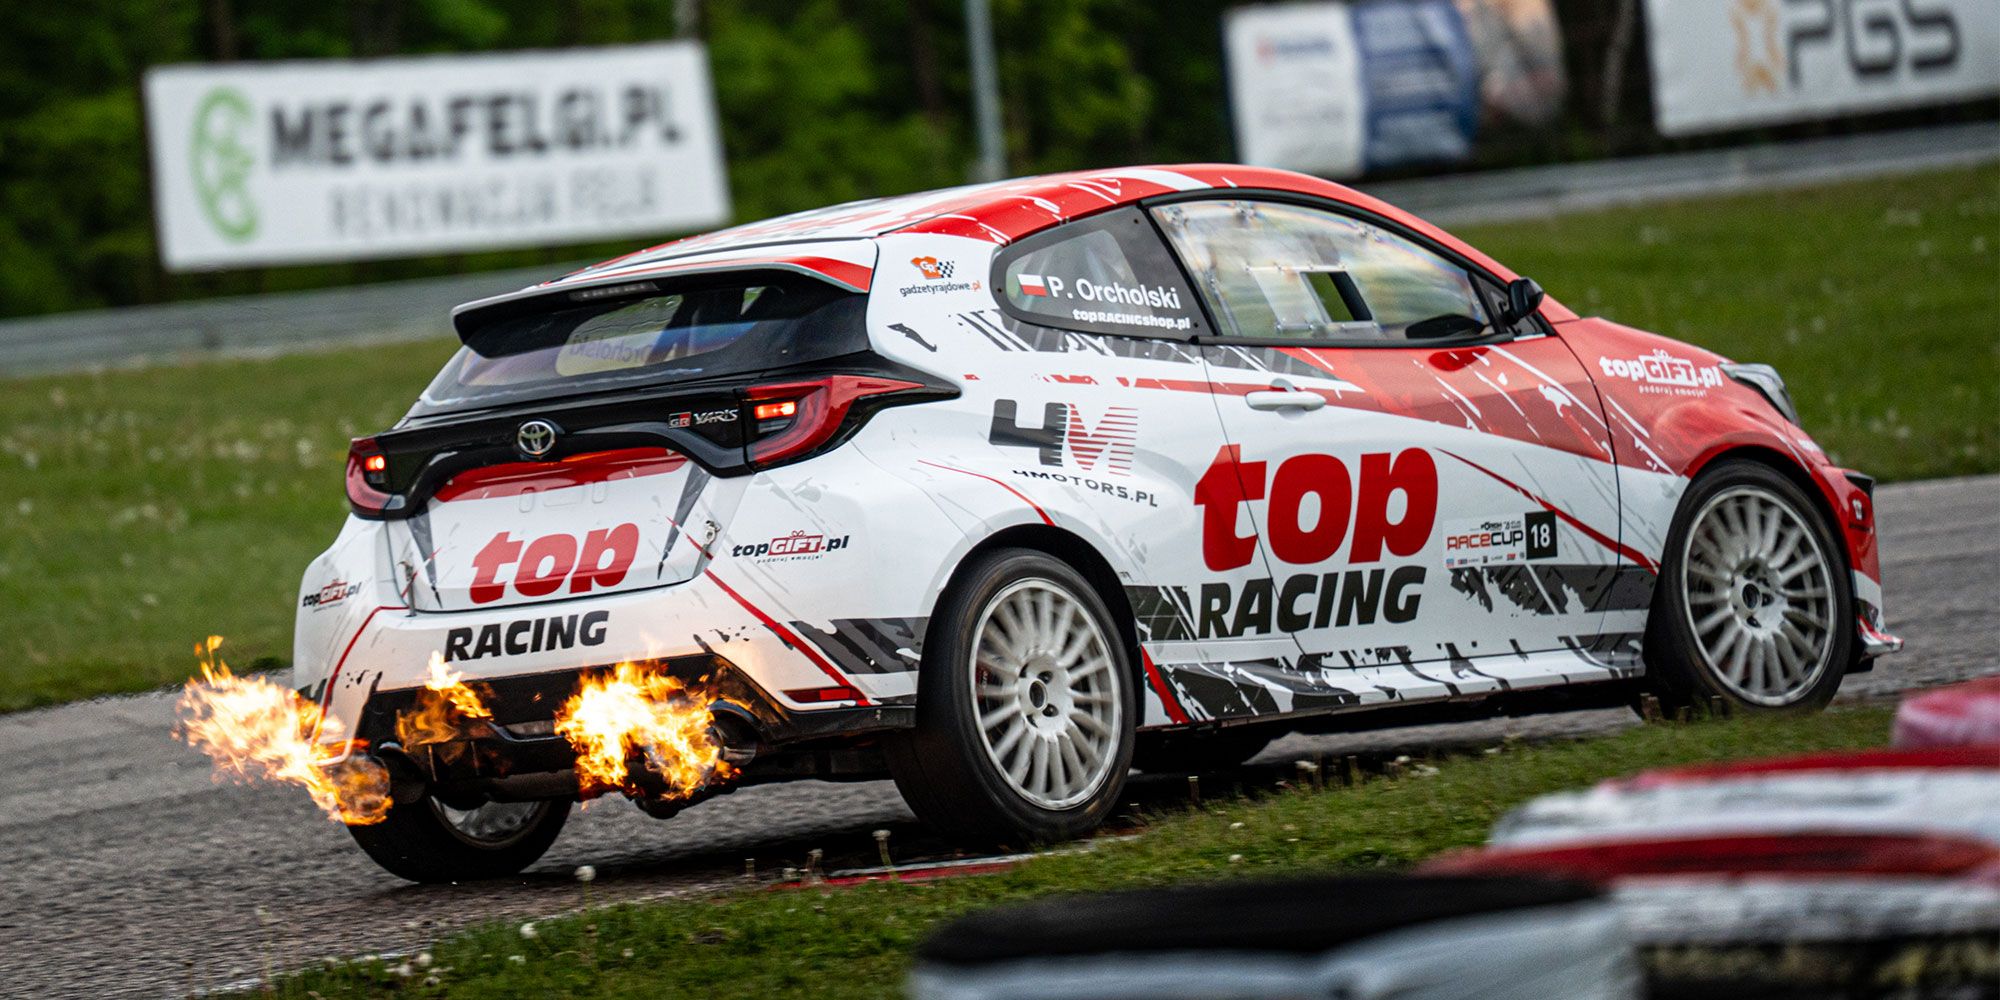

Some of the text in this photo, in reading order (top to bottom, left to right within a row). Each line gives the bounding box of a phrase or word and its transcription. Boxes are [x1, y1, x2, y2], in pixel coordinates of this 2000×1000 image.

[1785, 0, 1964, 90] PGS
[899, 279, 982, 298] gadzetyrajdowe.pl
[1046, 275, 1182, 310] P. Orcholski
[1072, 308, 1191, 331] topRACINGshop.pl
[1599, 355, 1724, 388] topGIFT.pl
[693, 408, 739, 425] YARIS
[1012, 469, 1159, 508] 4MOTORS.PL
[1193, 443, 1439, 573] top
[732, 534, 850, 558] topGIFT.pl
[1530, 522, 1551, 549] 18
[469, 521, 641, 605] top
[1199, 566, 1428, 640] RACING
[443, 609, 610, 663] RACING
